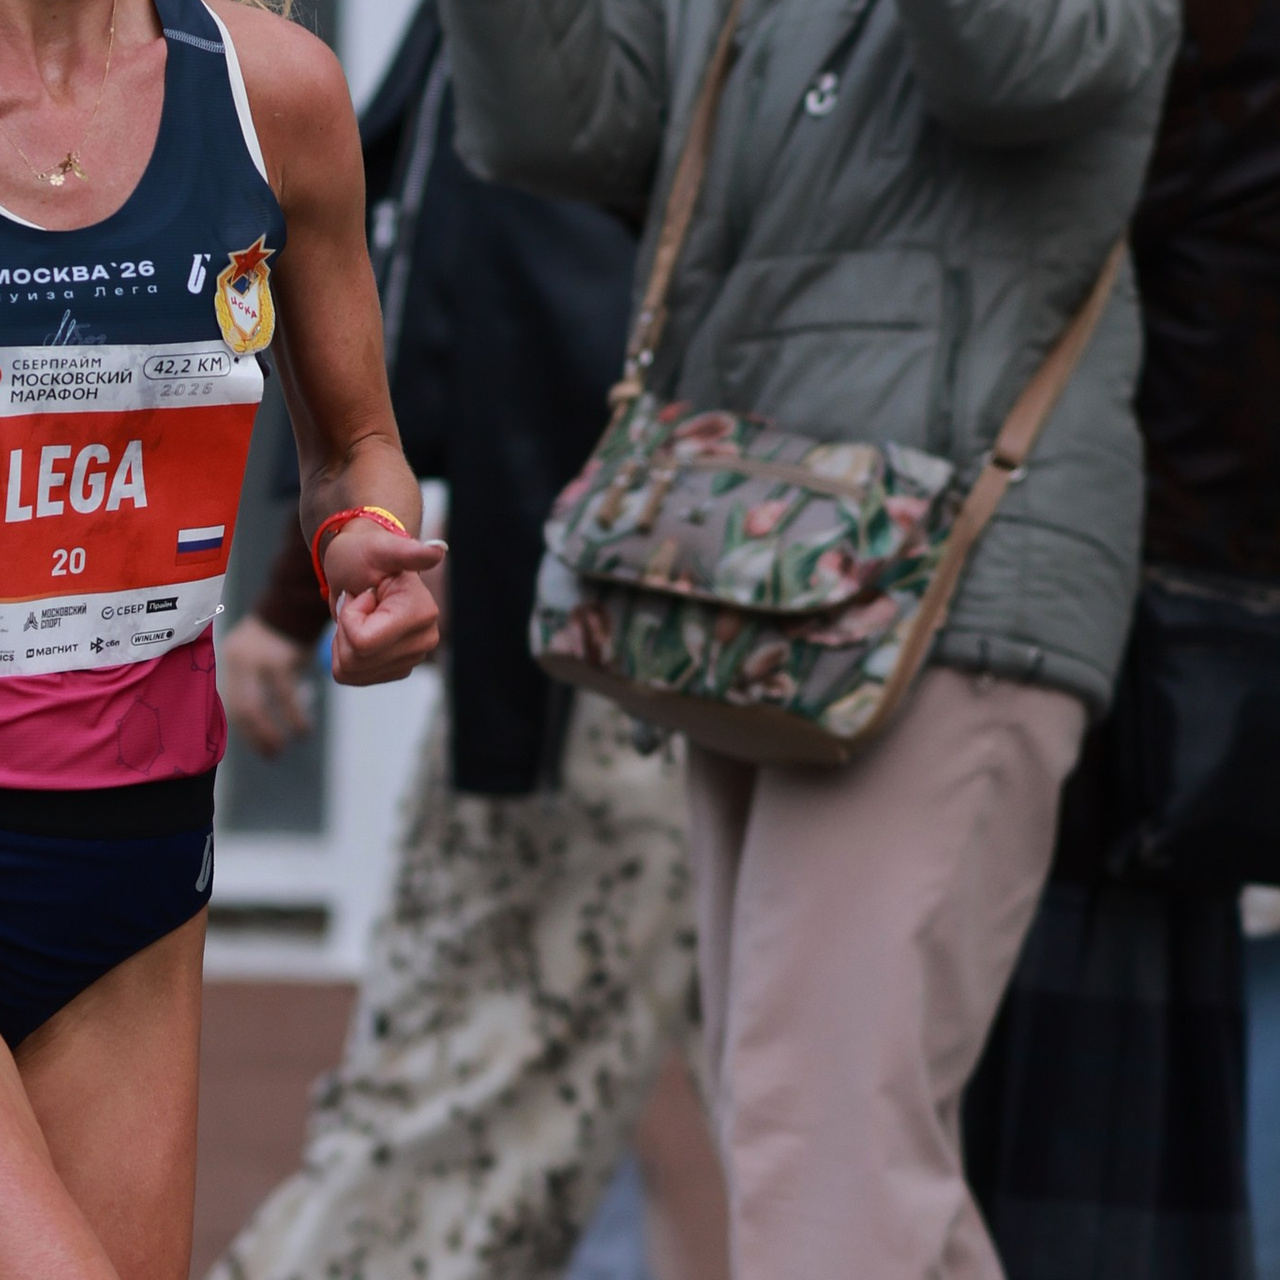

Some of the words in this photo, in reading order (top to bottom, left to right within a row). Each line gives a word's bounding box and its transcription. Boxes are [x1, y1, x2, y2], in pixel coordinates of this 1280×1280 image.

[94, 284, 158, 297] Лега
[230, 296, 258, 319] ЦСКА
[12, 355, 102, 370] СБЕРПРАЙМ
[153, 358, 191, 376] 42,2
[11, 368, 133, 387] МОСКОВСКИЙ
[10, 387, 99, 403] МАРАФОН
[160, 382, 214, 397] 2026
[4, 439, 148, 523] LEGA
[51, 547, 86, 577] 20
[41, 603, 87, 619] МОСКОВСКИЙ
[116, 603, 145, 616] СБЕР
[148, 600, 173, 611] Прайм
[40, 618, 62, 629] СПОРТ
[133, 631, 166, 644] WINLINE
